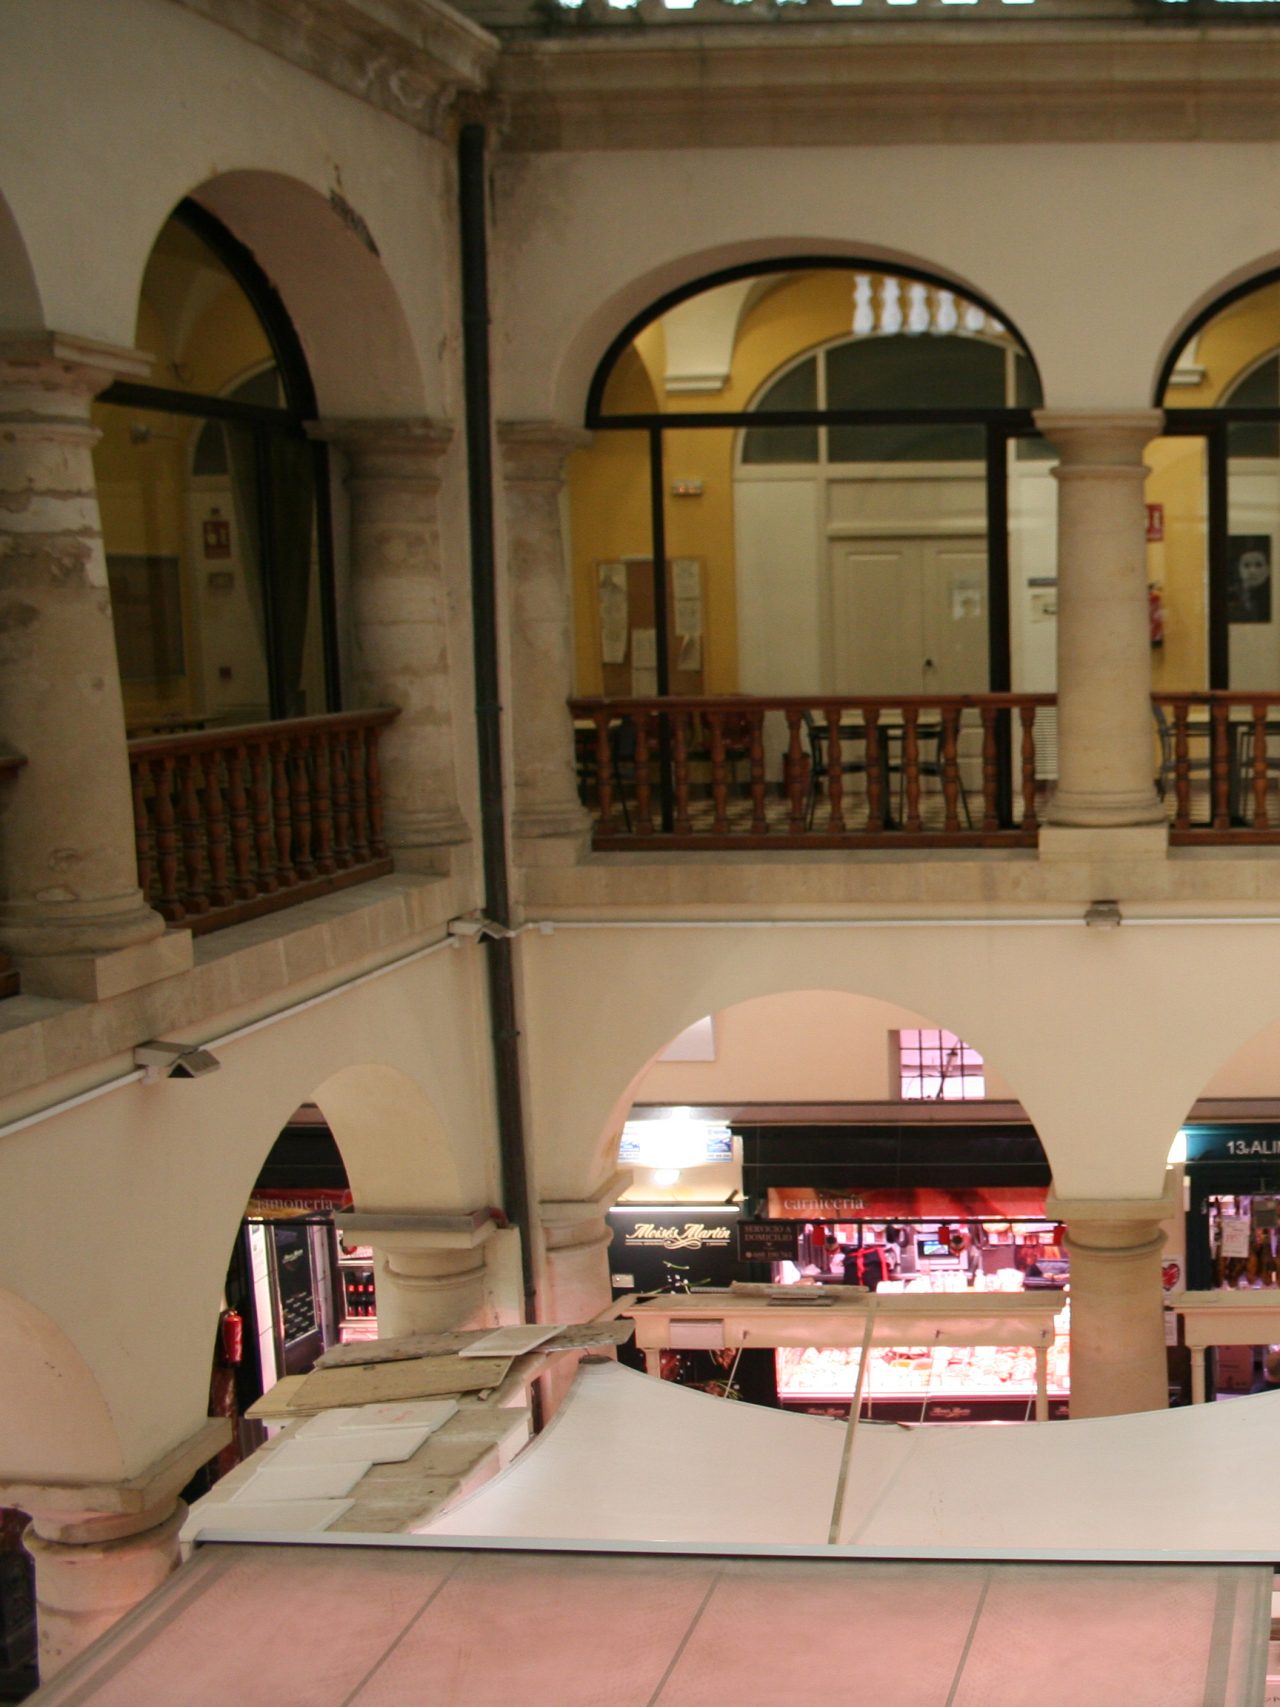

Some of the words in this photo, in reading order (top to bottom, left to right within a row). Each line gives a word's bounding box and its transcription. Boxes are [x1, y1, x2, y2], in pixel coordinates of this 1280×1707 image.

[255, 1195, 333, 1213] jamonería
[783, 1194, 865, 1210] carnicería
[625, 1223, 679, 1239] Moisés
[678, 1223, 731, 1239] Martín
